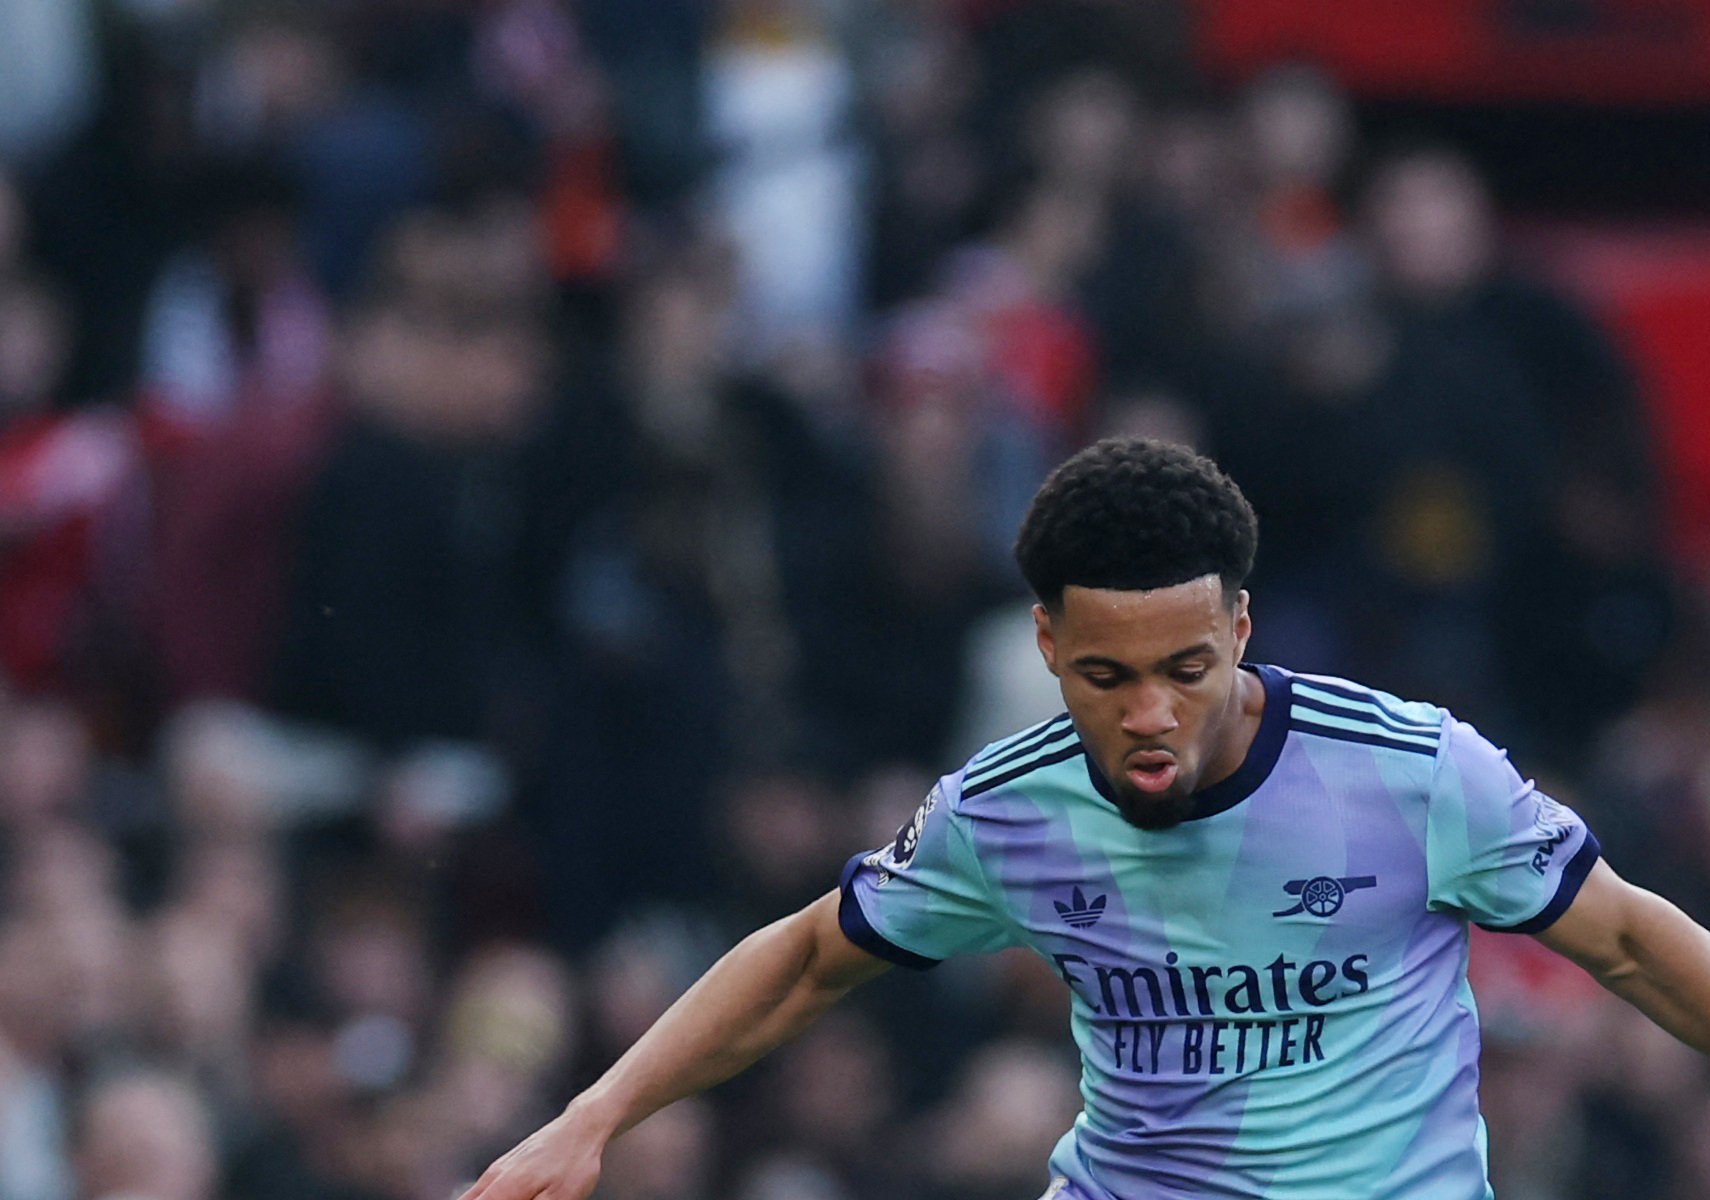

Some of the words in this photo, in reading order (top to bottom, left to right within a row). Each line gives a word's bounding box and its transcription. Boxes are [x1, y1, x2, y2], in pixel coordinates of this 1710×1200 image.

[1052, 951, 1368, 1018] Emirates
[1114, 1020, 1168, 1075] FLY
[1182, 1013, 1326, 1075] BETTER
